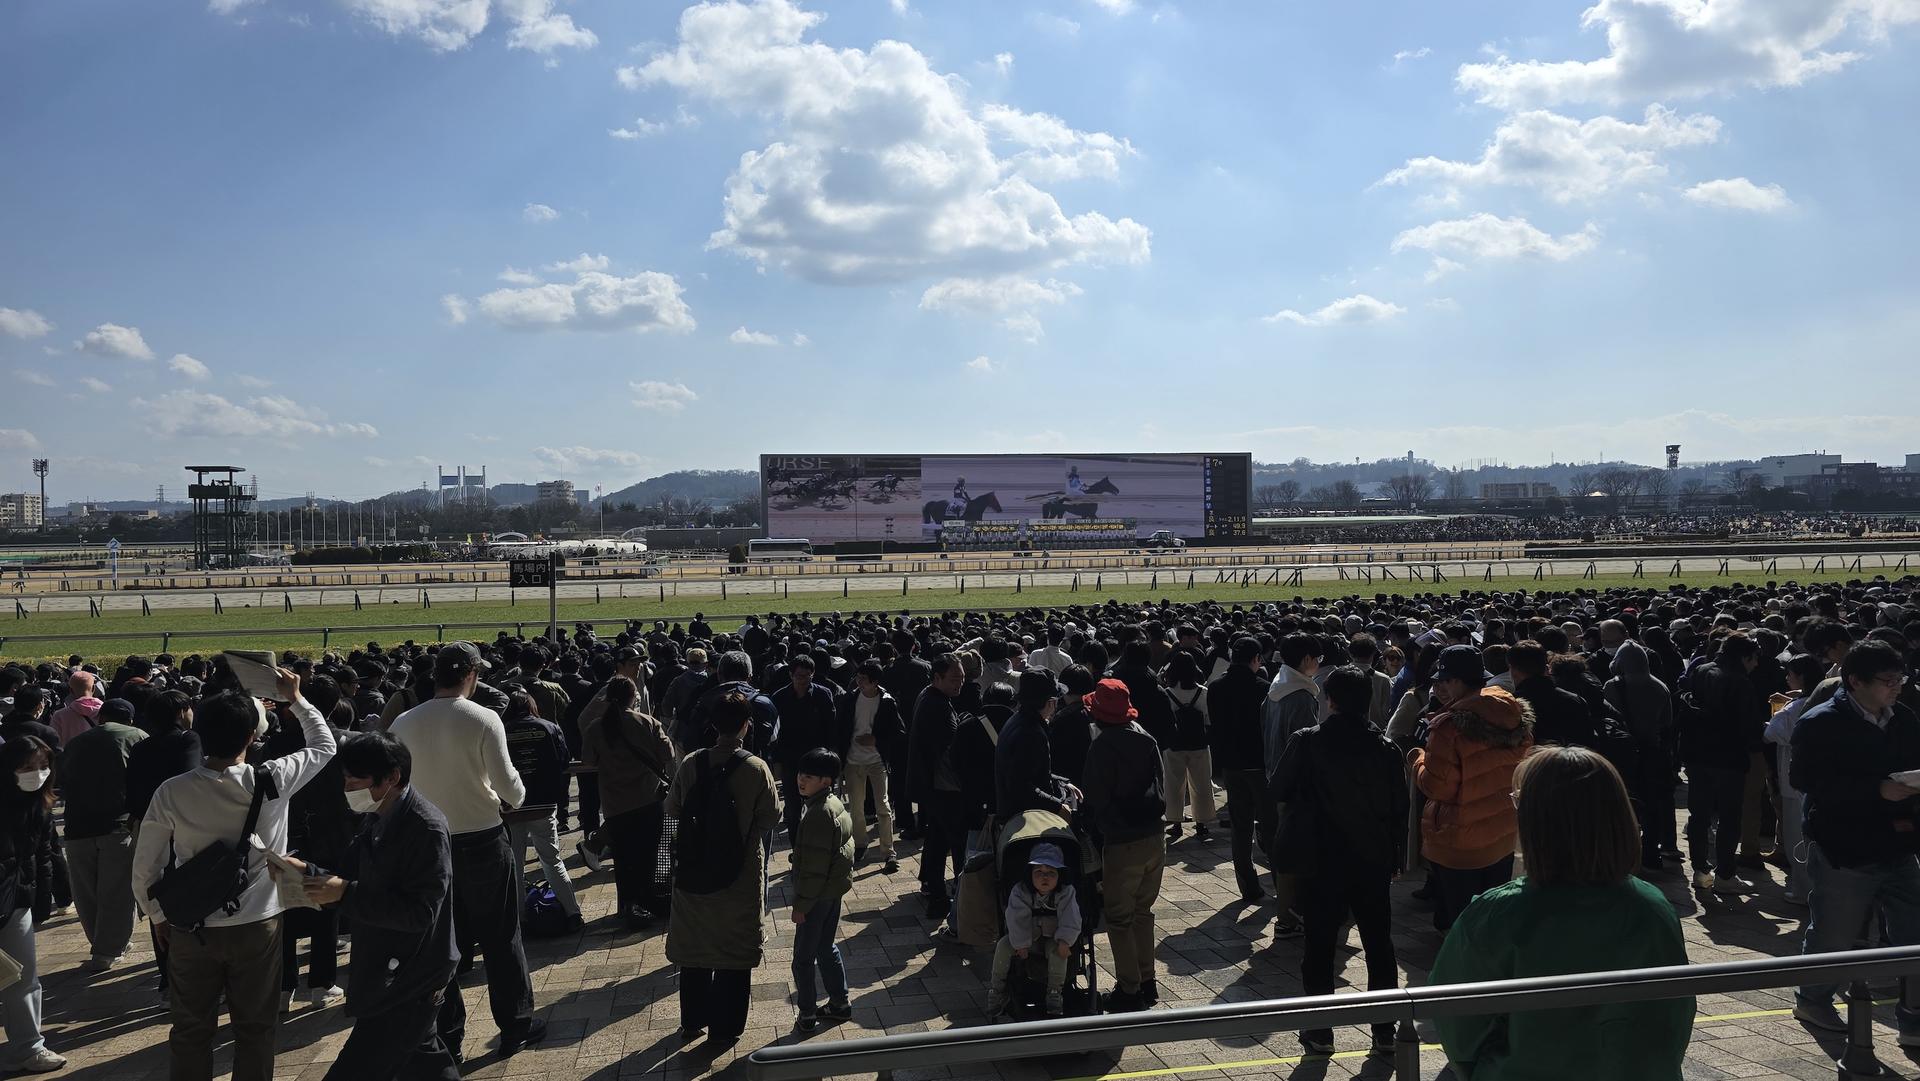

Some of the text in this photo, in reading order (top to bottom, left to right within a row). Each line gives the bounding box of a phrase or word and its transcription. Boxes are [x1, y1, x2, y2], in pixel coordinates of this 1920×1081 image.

[513, 563, 546, 573] 馬場内
[518, 574, 542, 584] 入口
